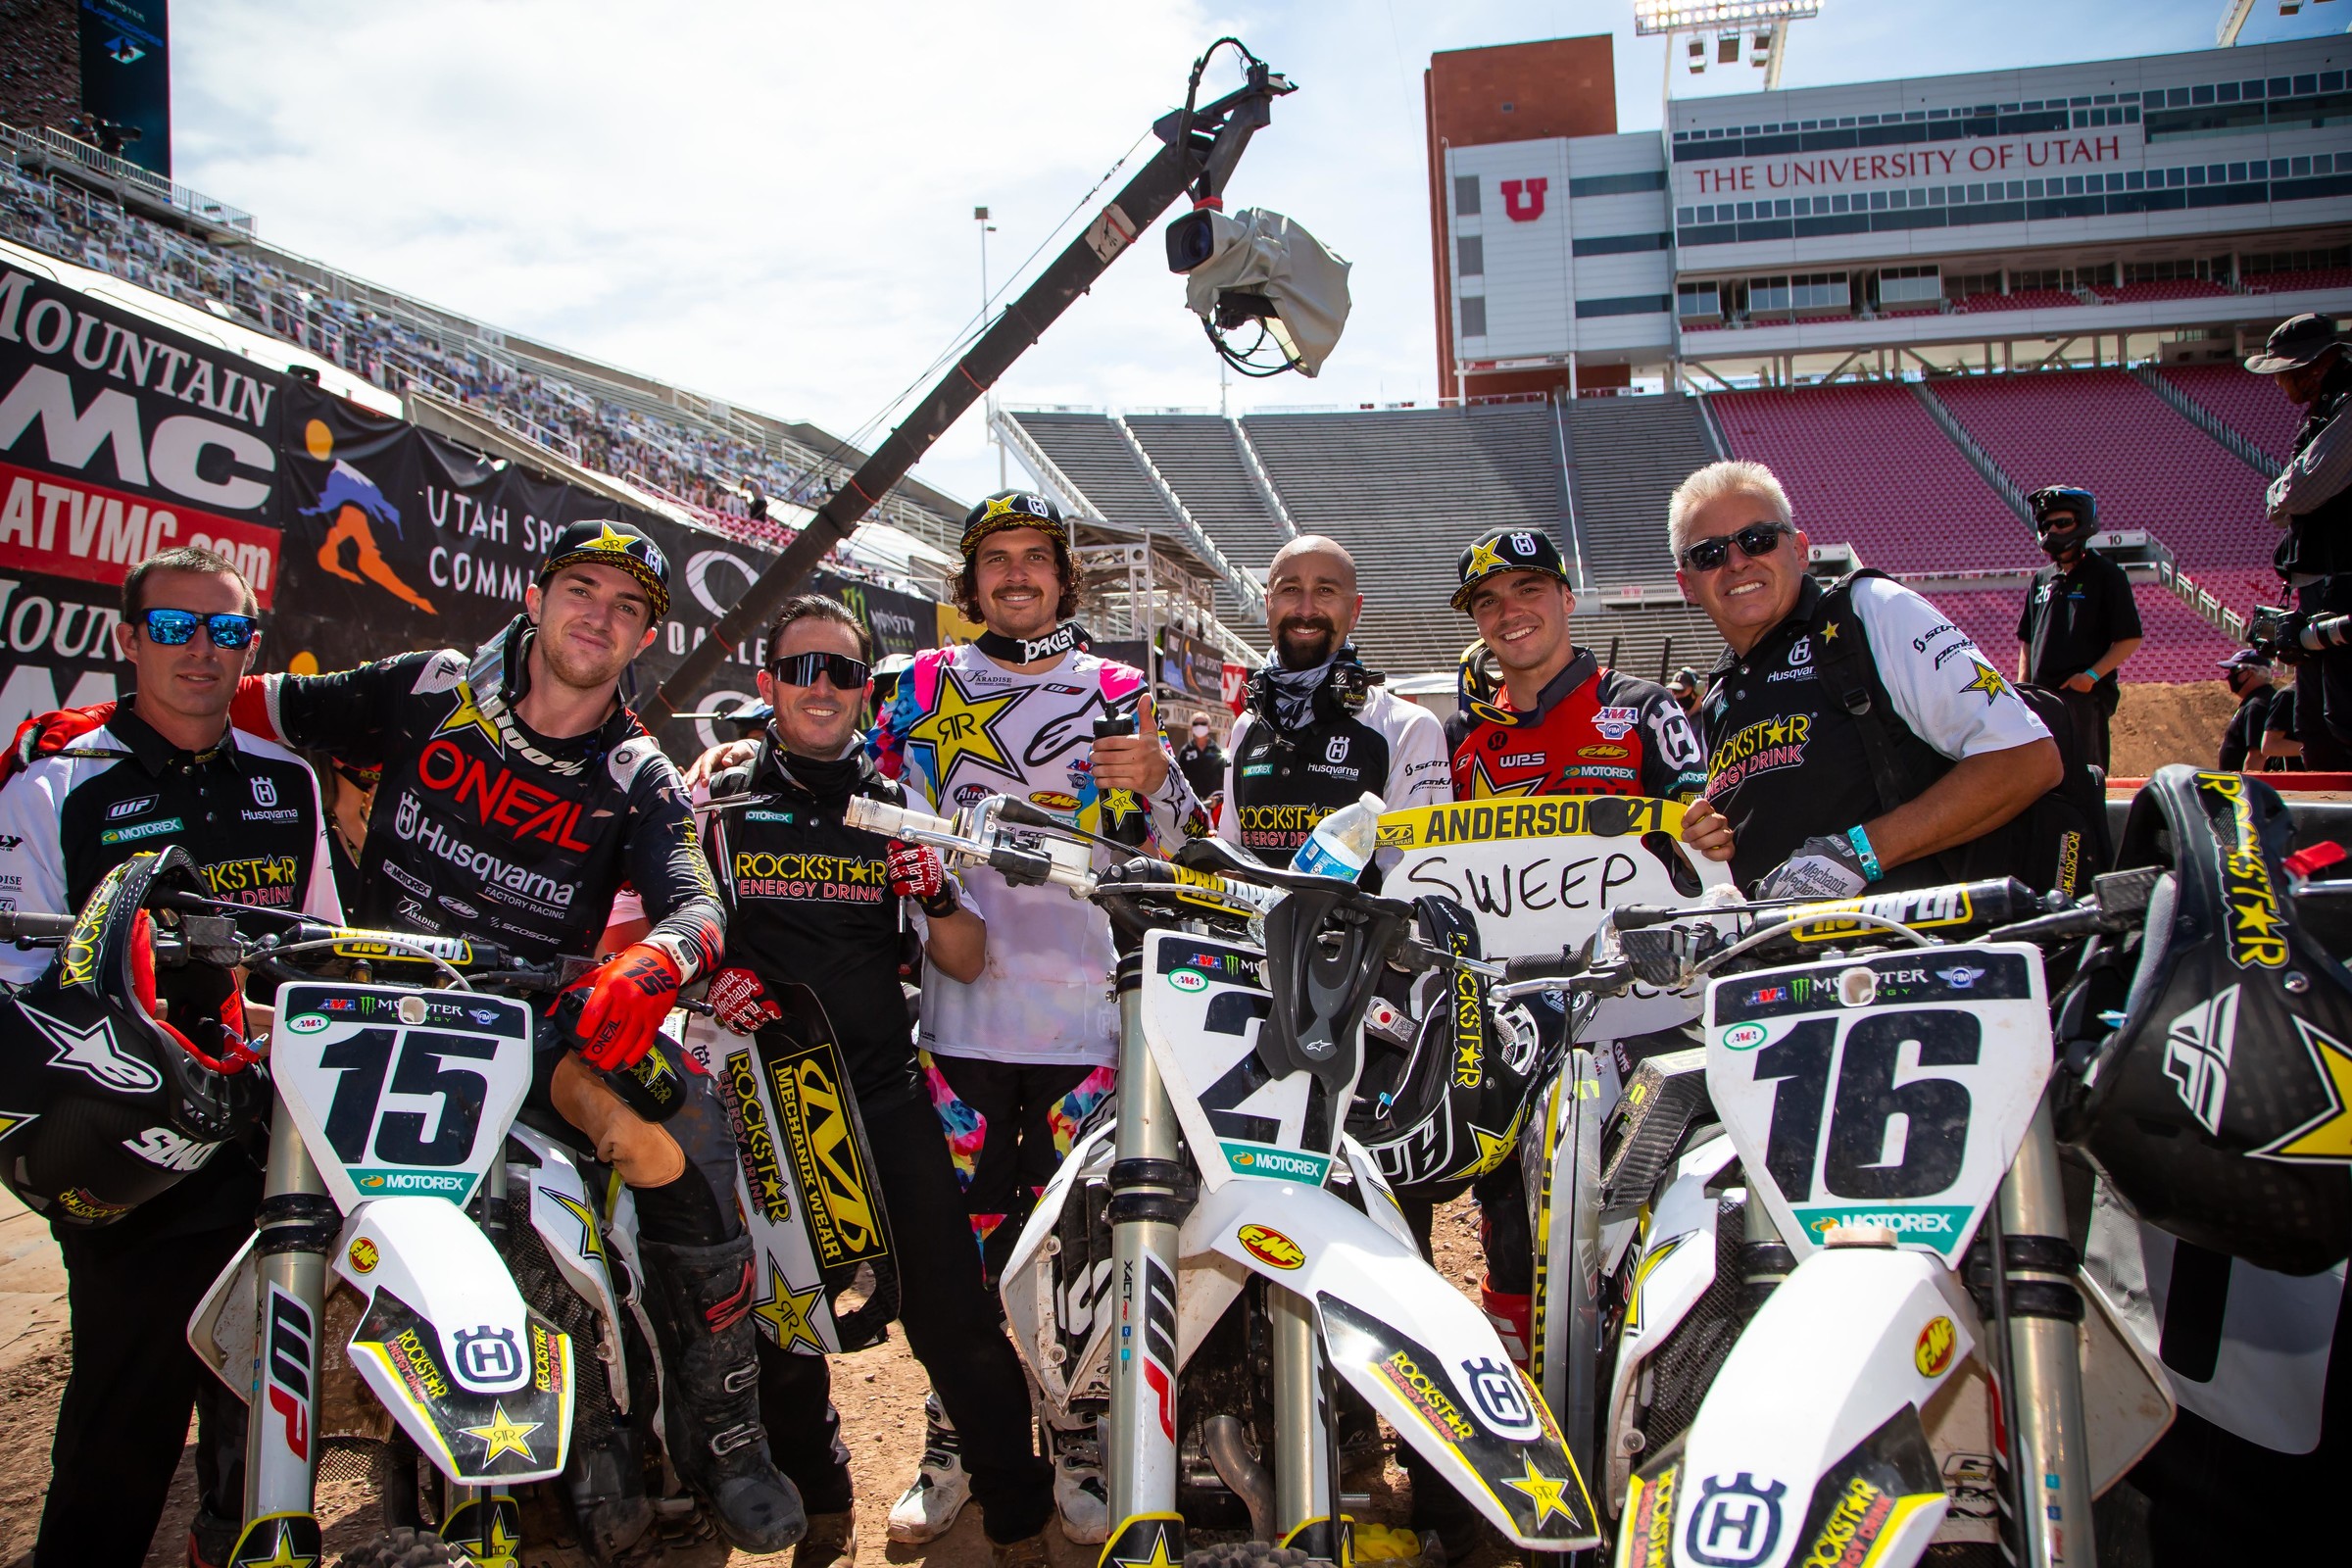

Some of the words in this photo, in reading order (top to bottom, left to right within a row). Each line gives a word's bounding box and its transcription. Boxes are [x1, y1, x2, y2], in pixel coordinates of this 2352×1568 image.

[1694, 165, 1755, 194] THE
[1766, 149, 1957, 189] UNIVERSITY
[1968, 144, 2014, 172] OF
[2027, 135, 2120, 168] UTAH
[0, 363, 276, 511] MC
[426, 485, 509, 545] UTAH
[2107, 534, 2123, 546] 10
[2034, 583, 2053, 605] 26
[1020, 626, 1076, 663] OAKLEY
[1593, 708, 1639, 721] AMA
[1607, 726, 1621, 735] FIM
[493, 708, 589, 778] 100%
[1577, 745, 1630, 759] FMF
[1749, 744, 1802, 774] DRINK
[1307, 762, 1360, 777] Husqvarna
[1414, 760, 1451, 772] SCOTT
[1498, 752, 1546, 768] WPS
[1581, 764, 1635, 780] MOTOREX
[418, 739, 592, 854] O'NEAL
[1029, 794, 1082, 810] FMF
[118, 817, 180, 841] MOTOREX
[241, 808, 299, 821] Husqvarna
[1629, 798, 1664, 833] 21
[416, 816, 574, 907] Husqvarna
[736, 851, 887, 885] ROCKSTAR
[1799, 859, 1849, 896] Mechanix
[392, 867, 431, 898] MOTOREX
[740, 879, 818, 898] ENERGY
[823, 881, 883, 903] DRINK
[1407, 853, 1638, 918] SWEEP
[483, 886, 528, 910] FACTORY
[528, 904, 565, 921] RACING
[1438, 902, 1459, 926] Airoh
[500, 922, 563, 946] SCOSCHE
[1186, 953, 1223, 970] AMA
[1175, 975, 1200, 987] AMA
[1952, 972, 1970, 984] FIM
[317, 998, 357, 1011] AMA
[1745, 986, 1788, 1005] AMA
[297, 1018, 322, 1029] AMA
[1731, 1030, 1758, 1044] AMA
[1614, 1041, 1632, 1074] GUTS
[318, 1028, 500, 1167] 15
[1752, 1008, 1983, 1203] 16
[721, 1071, 749, 1145] ENERGY
[740, 1152, 766, 1211] DRINK
[728, 1052, 792, 1224] ROCKSTAR
[775, 1064, 817, 1187] MECHANIX
[808, 1191, 844, 1260] WEAR
[1255, 1152, 1321, 1177] MOTOREX
[386, 1173, 465, 1192] MOTOREX
[1838, 1213, 1954, 1234] MOTOREX
[348, 1239, 380, 1271] FMF
[1238, 1223, 1306, 1270] FMF
[1123, 1259, 1134, 1303] XACT
[385, 1340, 411, 1374] ENERGY
[532, 1324, 553, 1393] ROCKSTAR
[1915, 1314, 1958, 1376] FMF
[397, 1326, 449, 1399] ROCKSTAR
[550, 1360, 563, 1394] ENERGY
[1380, 1361, 1426, 1407] ENERGY
[1421, 1402, 1459, 1443] DRINK
[1388, 1349, 1475, 1442] ROCKSTAR
